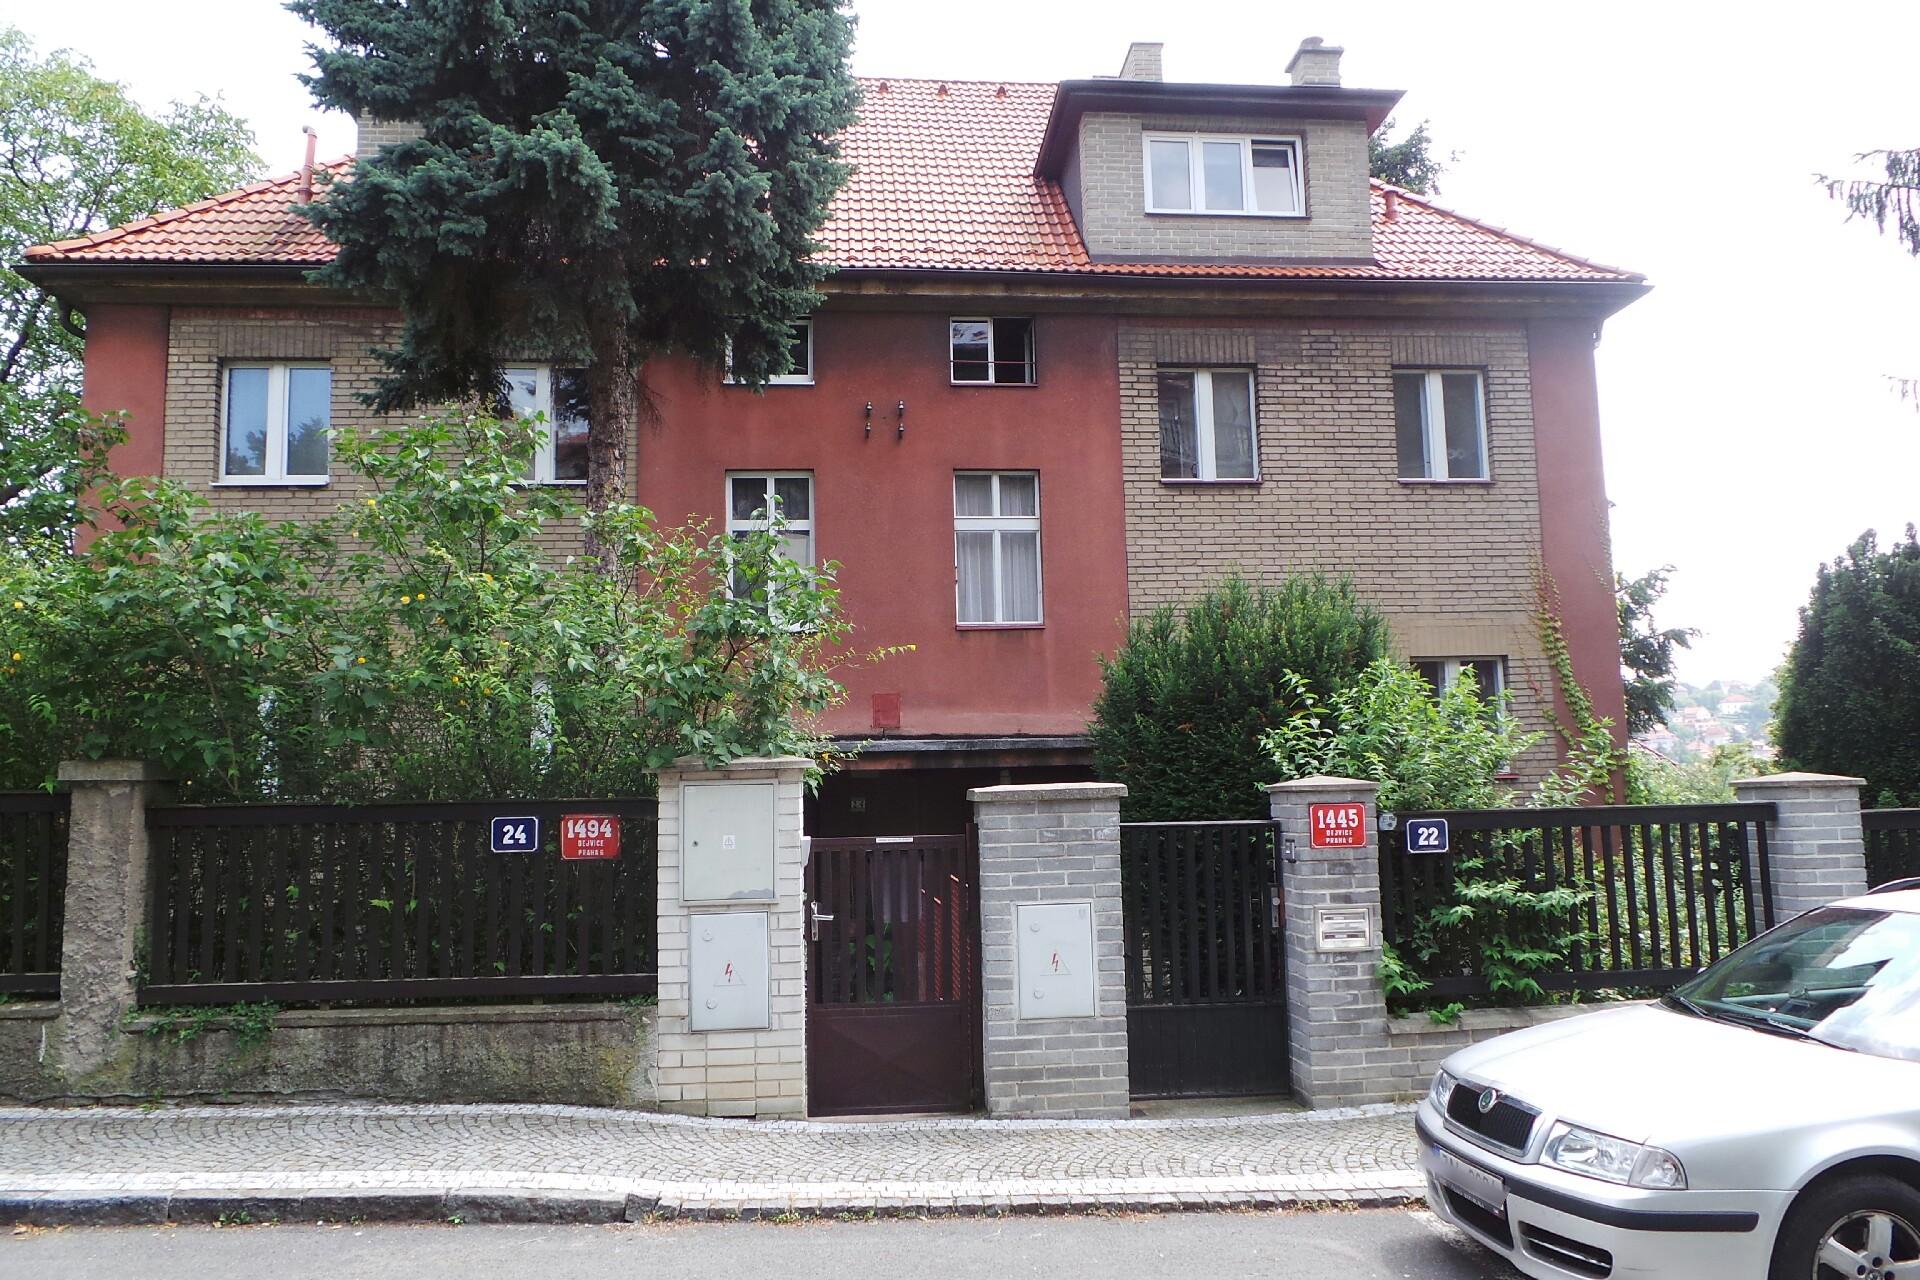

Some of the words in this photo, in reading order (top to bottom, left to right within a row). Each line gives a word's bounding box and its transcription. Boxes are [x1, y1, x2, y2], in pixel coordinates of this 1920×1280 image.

[1317, 808, 1359, 829] 1445
[502, 824, 527, 845] 24
[567, 819, 612, 838] 1494
[1418, 827, 1439, 846] 22
[577, 839, 604, 847] DEJVICE
